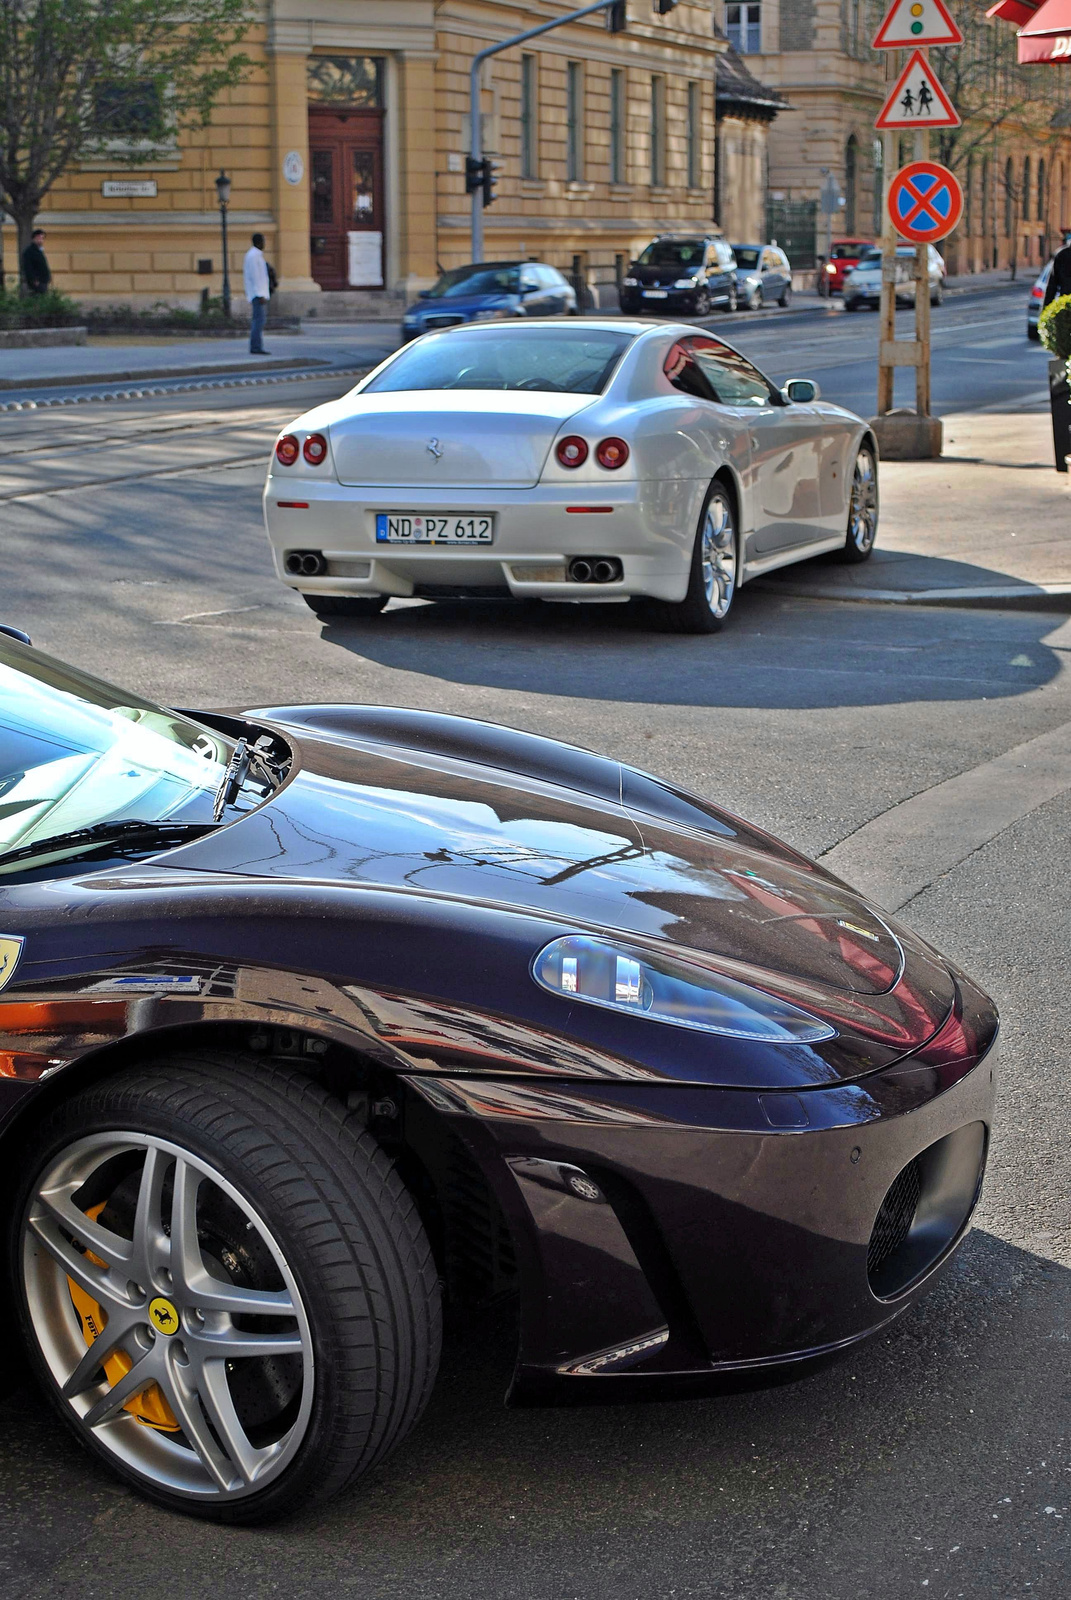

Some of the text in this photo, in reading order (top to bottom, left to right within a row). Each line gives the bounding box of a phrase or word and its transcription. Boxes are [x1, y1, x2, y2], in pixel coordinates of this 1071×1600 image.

[388, 518, 489, 539] ND PZ 612
